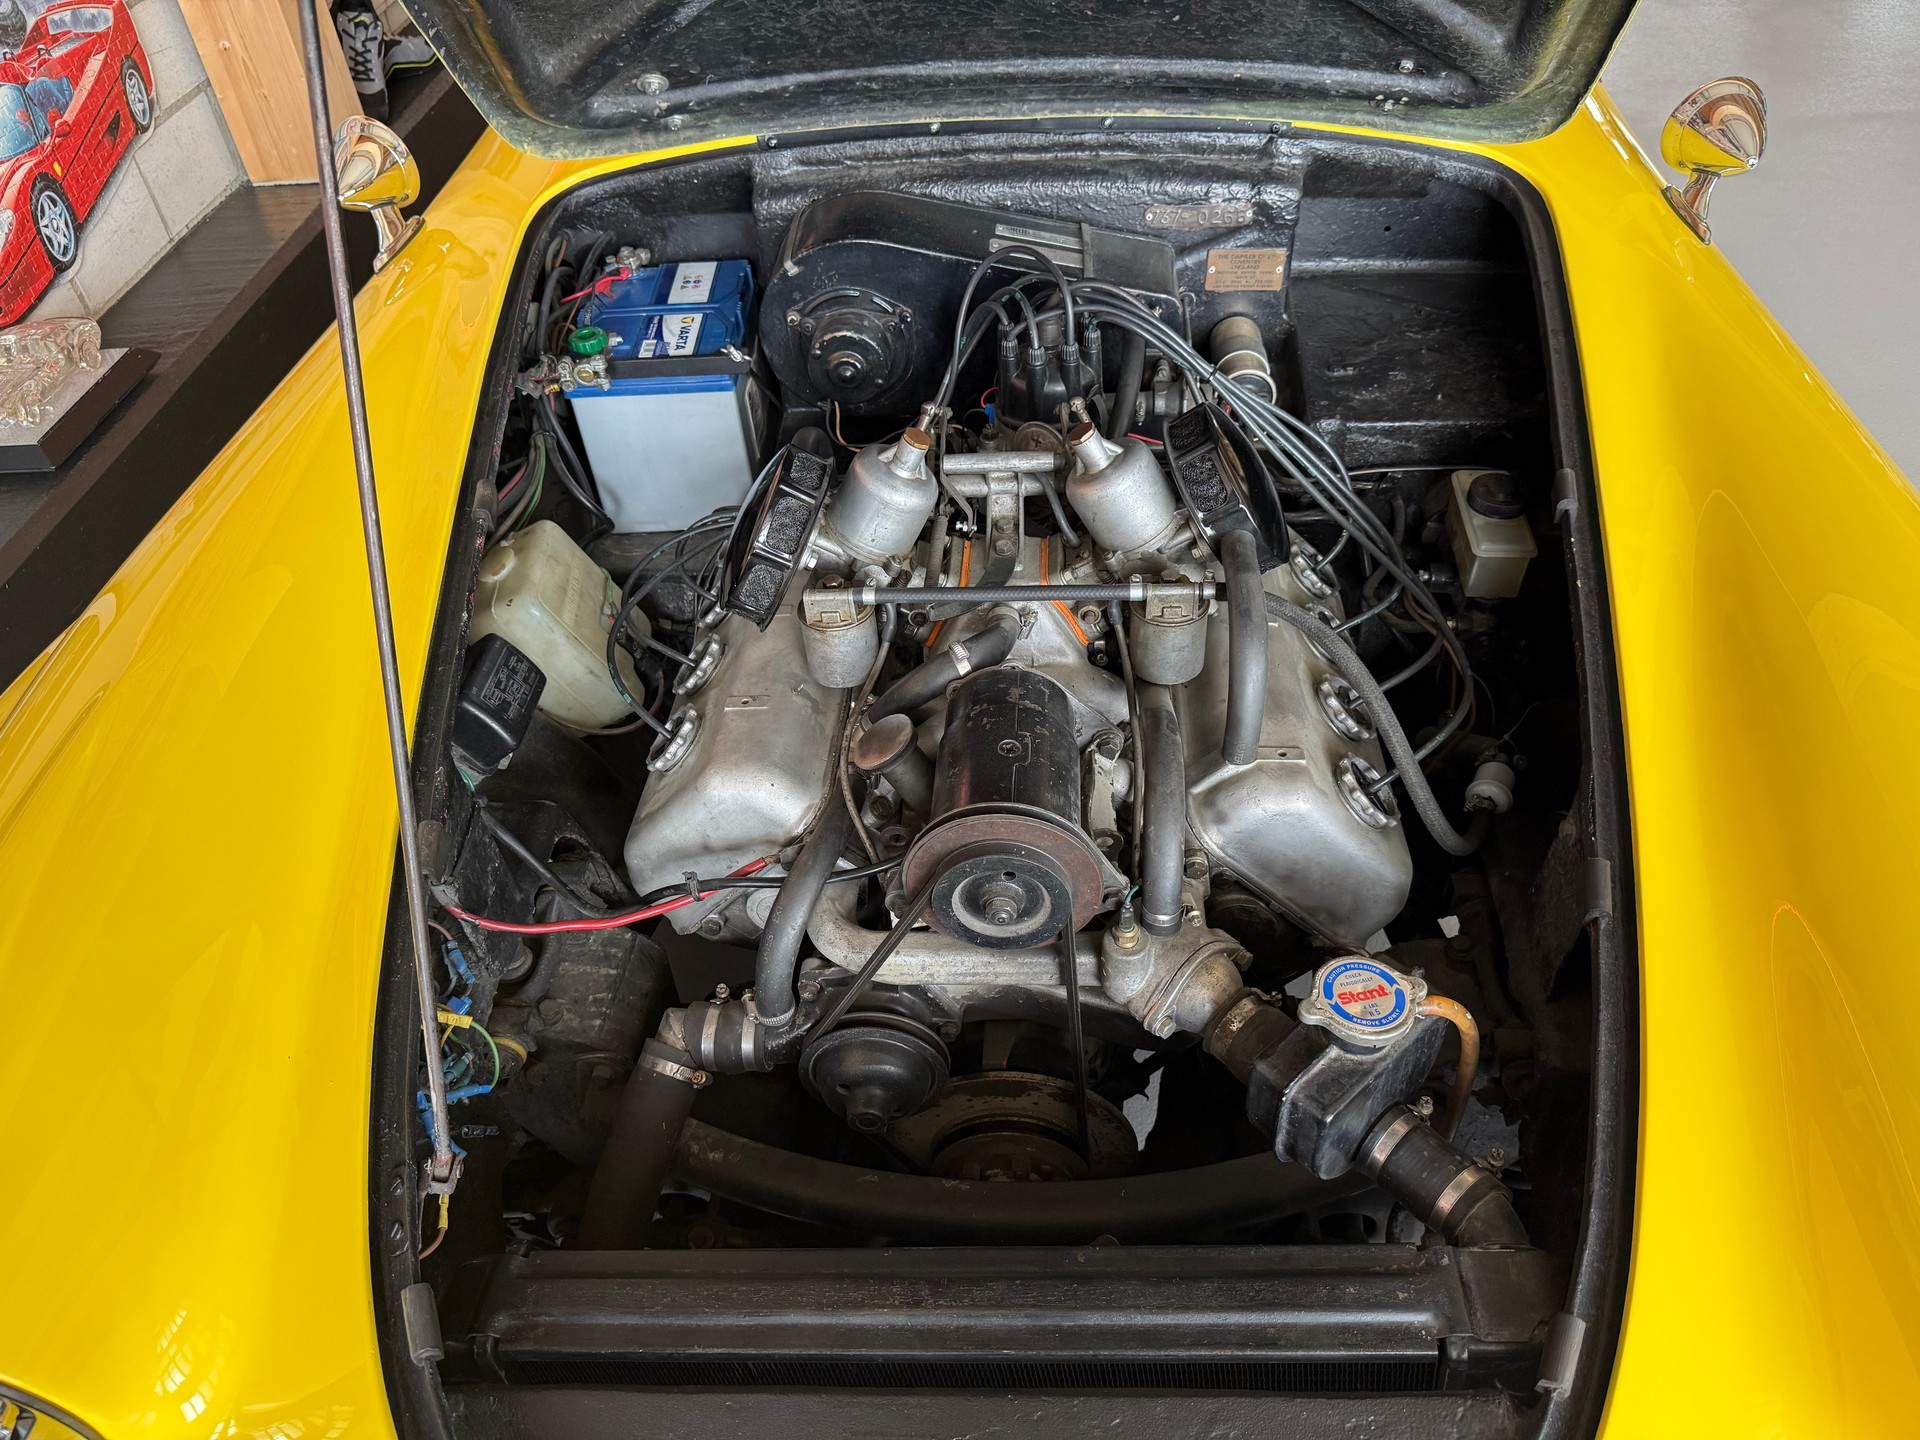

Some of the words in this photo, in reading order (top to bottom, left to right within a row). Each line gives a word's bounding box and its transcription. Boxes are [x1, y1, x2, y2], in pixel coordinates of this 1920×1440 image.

[674, 325, 692, 351] VARTA
[1326, 967, 1345, 984] CAUTION
[1346, 963, 1382, 974] PRESSURE
[1339, 976, 1374, 988] PERIODICALLY
[1344, 972, 1363, 980] CHECK
[1337, 984, 1389, 1006] Stant
[1352, 1017, 1380, 1026] REMOVE
[1381, 1008, 1401, 1024] SLOWLY
